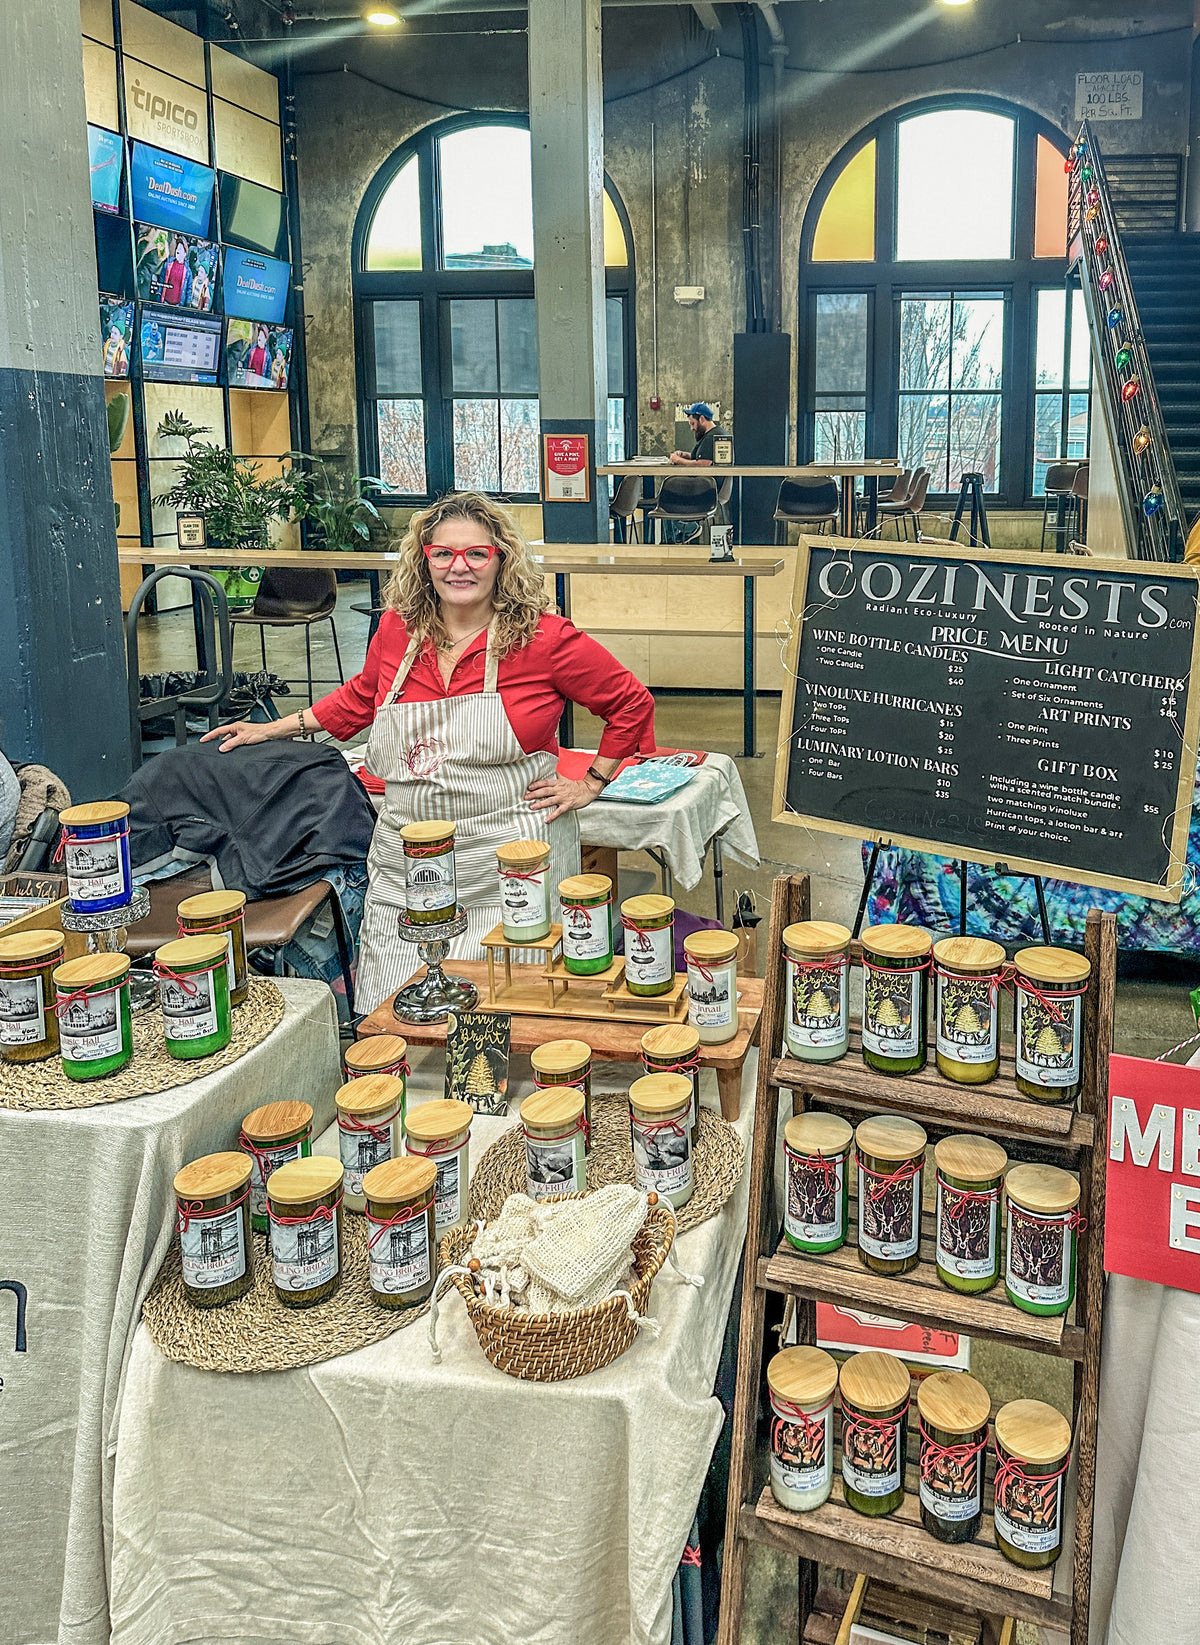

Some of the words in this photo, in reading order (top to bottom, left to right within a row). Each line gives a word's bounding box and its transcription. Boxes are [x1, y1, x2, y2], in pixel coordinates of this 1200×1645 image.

[1078, 74, 1109, 84] FLOOR
[1114, 73, 1141, 85] LOAD
[130, 78, 198, 131] tipico
[1087, 93, 1106, 104] 100
[157, 121, 204, 146] SPORTSBOOK
[148, 176, 197, 203] DealDash.com
[866, 603, 909, 615] Radiant
[914, 607, 978, 623] Eco-Luxury
[1039, 621, 1077, 634] Rooted
[1085, 626, 1095, 635] in
[1104, 629, 1149, 640] Nature
[813, 628, 846, 643] WINE
[849, 634, 901, 652] BOTTLE
[904, 642, 969, 664] CANDLES
[931, 626, 989, 647] PRICE
[1000, 630, 1069, 655] MENU
[819, 657, 834, 666] Two
[835, 659, 865, 671] Candles
[948, 665, 963, 674] $25
[948, 678, 964, 686] $40
[1013, 677, 1031, 687] One
[1033, 680, 1078, 692] Ornament
[1045, 662, 1095, 680] LIGHT
[1097, 668, 1185, 692] CATCHERS
[805, 683, 871, 704] VINOLUXE
[873, 692, 963, 718] HURRICANES
[812, 701, 828, 710] Two
[1011, 690, 1026, 699] Set
[1027, 691, 1037, 700] of
[1038, 694, 1051, 703] Six
[1053, 695, 1104, 709] Ornaments
[811, 713, 831, 723] Three
[939, 719, 954, 728] $15
[1007, 721, 1025, 731] One
[1038, 707, 1070, 722] ART
[1073, 711, 1133, 731] PRINTS
[810, 725, 827, 733] Four
[938, 731, 954, 741] $20
[1006, 734, 1031, 745] Three
[797, 737, 864, 760] LUMINARY
[867, 749, 920, 771] LOTION
[924, 758, 960, 777] BARS
[937, 746, 953, 755] $25
[808, 757, 823, 765] One
[828, 759, 841, 768] Bar
[1037, 758, 1080, 776] GIFT
[1083, 764, 1119, 782] BOX
[808, 769, 824, 777] Four
[826, 771, 844, 781] Bars
[937, 779, 951, 788] $10
[935, 790, 950, 799] $35
[989, 774, 1029, 789] Including
[1039, 783, 1059, 792] wine
[1061, 784, 1088, 796] bottle
[1090, 790, 1121, 802] candle
[990, 783, 1009, 792] with
[1017, 786, 1052, 799] scented
[1053, 792, 1082, 804] match
[987, 795, 1004, 804] two
[1006, 797, 1048, 813] matching
[1049, 805, 1089, 819] Vinoluxe
[1143, 804, 1160, 815] $55
[986, 808, 1023, 821] Hurrican
[1024, 814, 1046, 826] tops,
[1055, 819, 1081, 831] lotion
[1083, 823, 1099, 834] bar
[1100, 827, 1107, 835] &
[1108, 829, 1124, 839] art
[1008, 824, 1017, 833] of
[1017, 827, 1038, 837] your
[1039, 830, 1071, 843] choice.
[460, 1026, 506, 1050] Bright
[206, 1255, 239, 1270] BRIDGE
[303, 1254, 334, 1274] BRIDGE
[395, 1259, 425, 1277] BRIDGE
